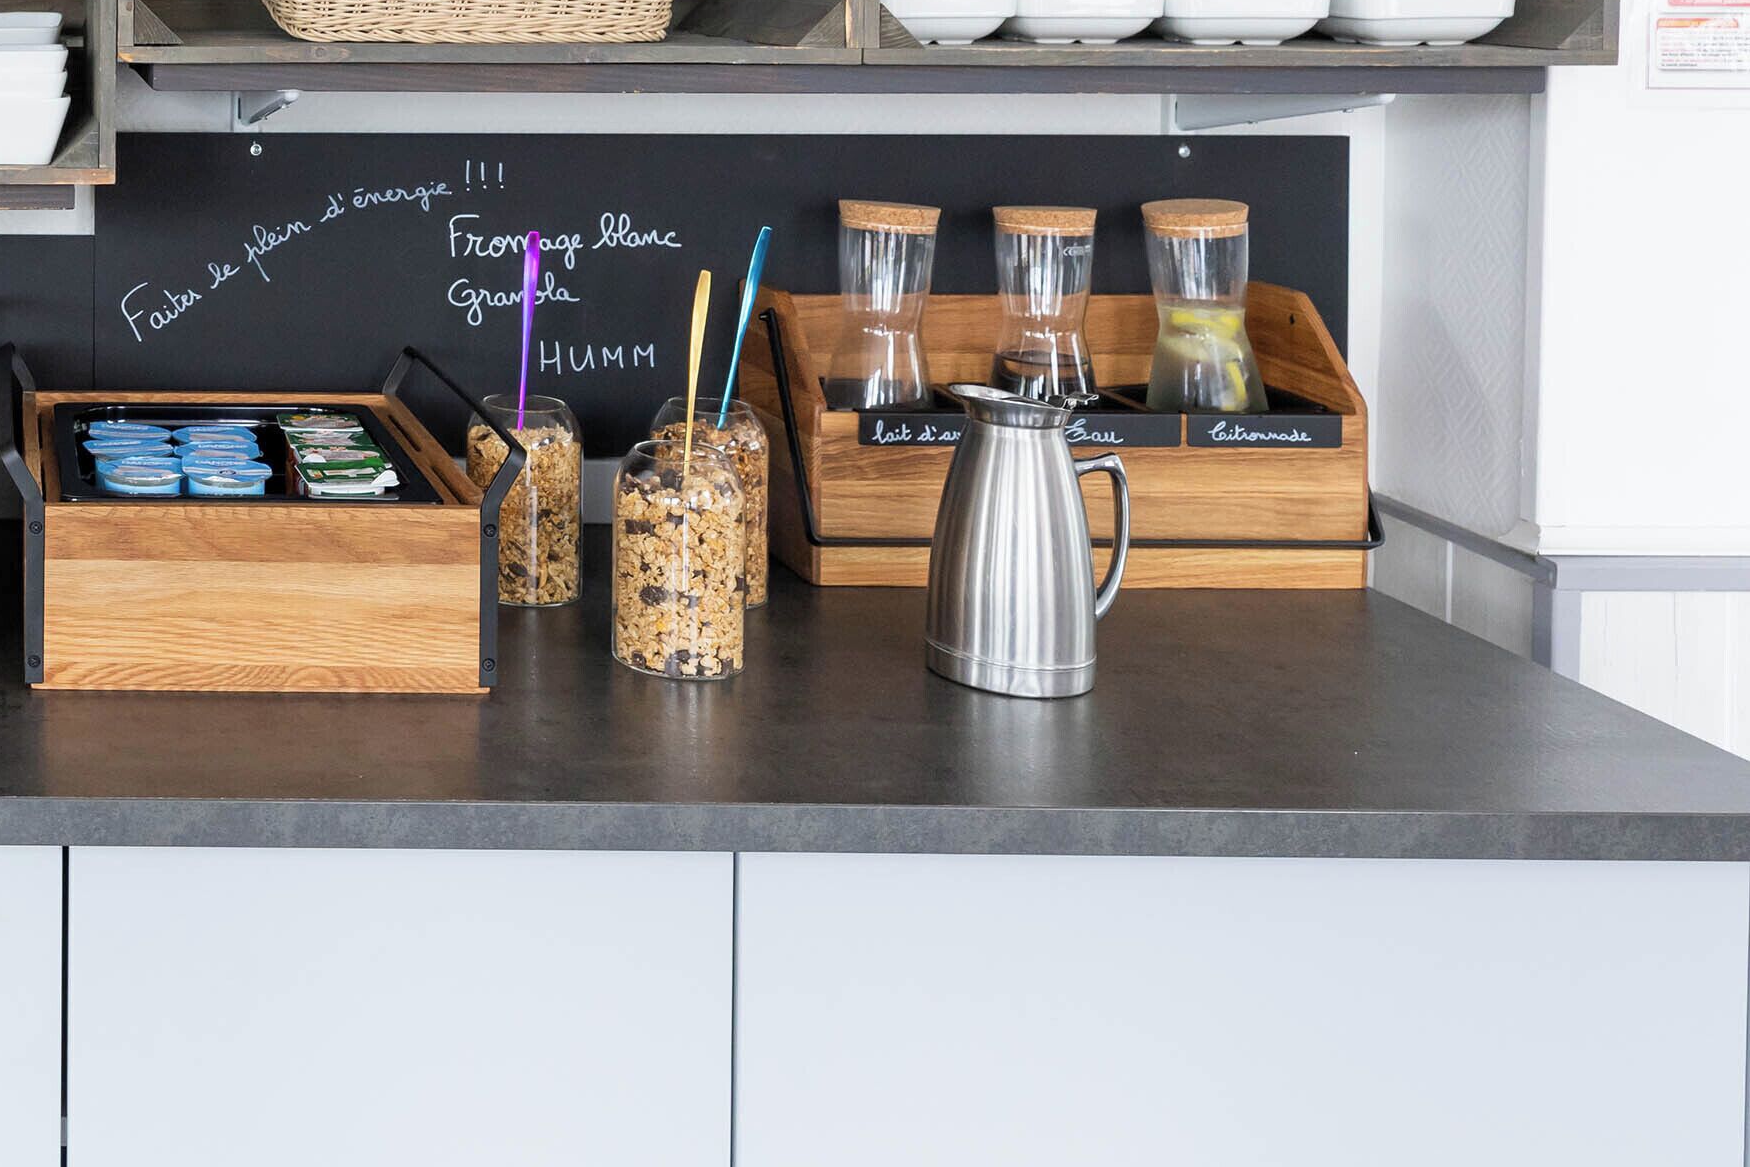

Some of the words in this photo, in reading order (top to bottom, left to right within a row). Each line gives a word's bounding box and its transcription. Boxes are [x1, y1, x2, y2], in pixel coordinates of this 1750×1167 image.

[120, 281, 203, 342] Faites
[207, 261, 241, 290] le
[243, 220, 312, 283] plein
[464, 159, 504, 191] !!!
[448, 213, 584, 271] Fromage
[591, 211, 683, 249] blanc
[447, 271, 581, 327] Granola
[538, 339, 657, 376] HUMM
[871, 419, 913, 444] lait
[1064, 417, 1125, 444] Eau
[1207, 420, 1313, 443] Citronnade
